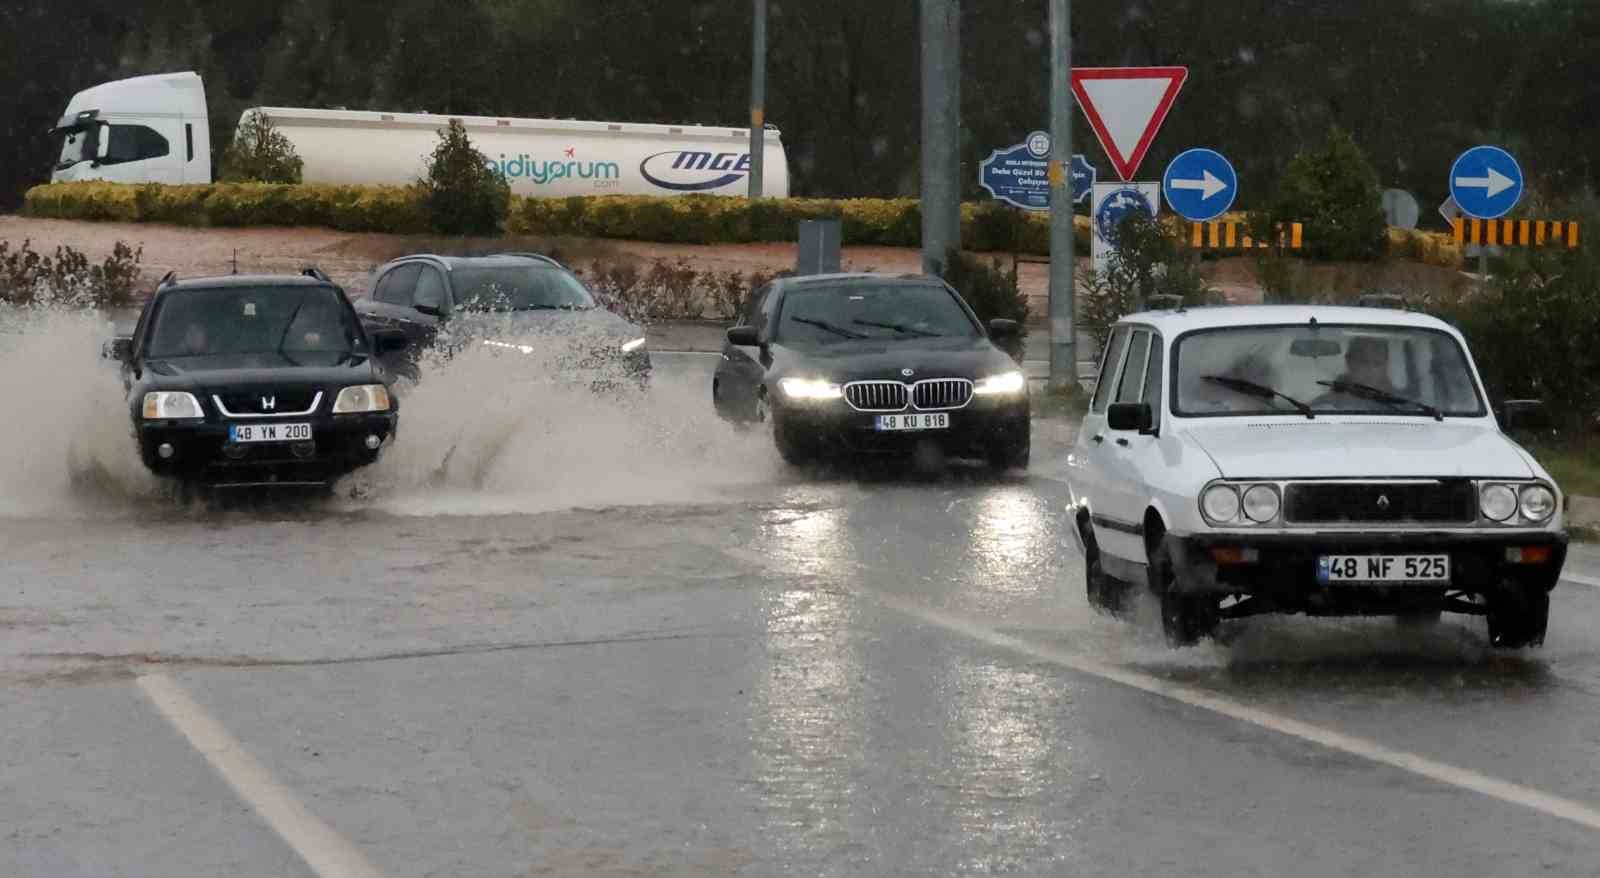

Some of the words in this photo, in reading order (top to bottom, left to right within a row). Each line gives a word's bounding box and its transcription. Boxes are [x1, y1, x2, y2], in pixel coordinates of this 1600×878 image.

[883, 415, 897, 429] 48
[904, 415, 918, 428] KU
[260, 426, 276, 439] YN
[286, 425, 309, 438] 200
[1330, 557, 1358, 578] 48
[1367, 557, 1395, 578] NF
[1405, 557, 1446, 578] 525
